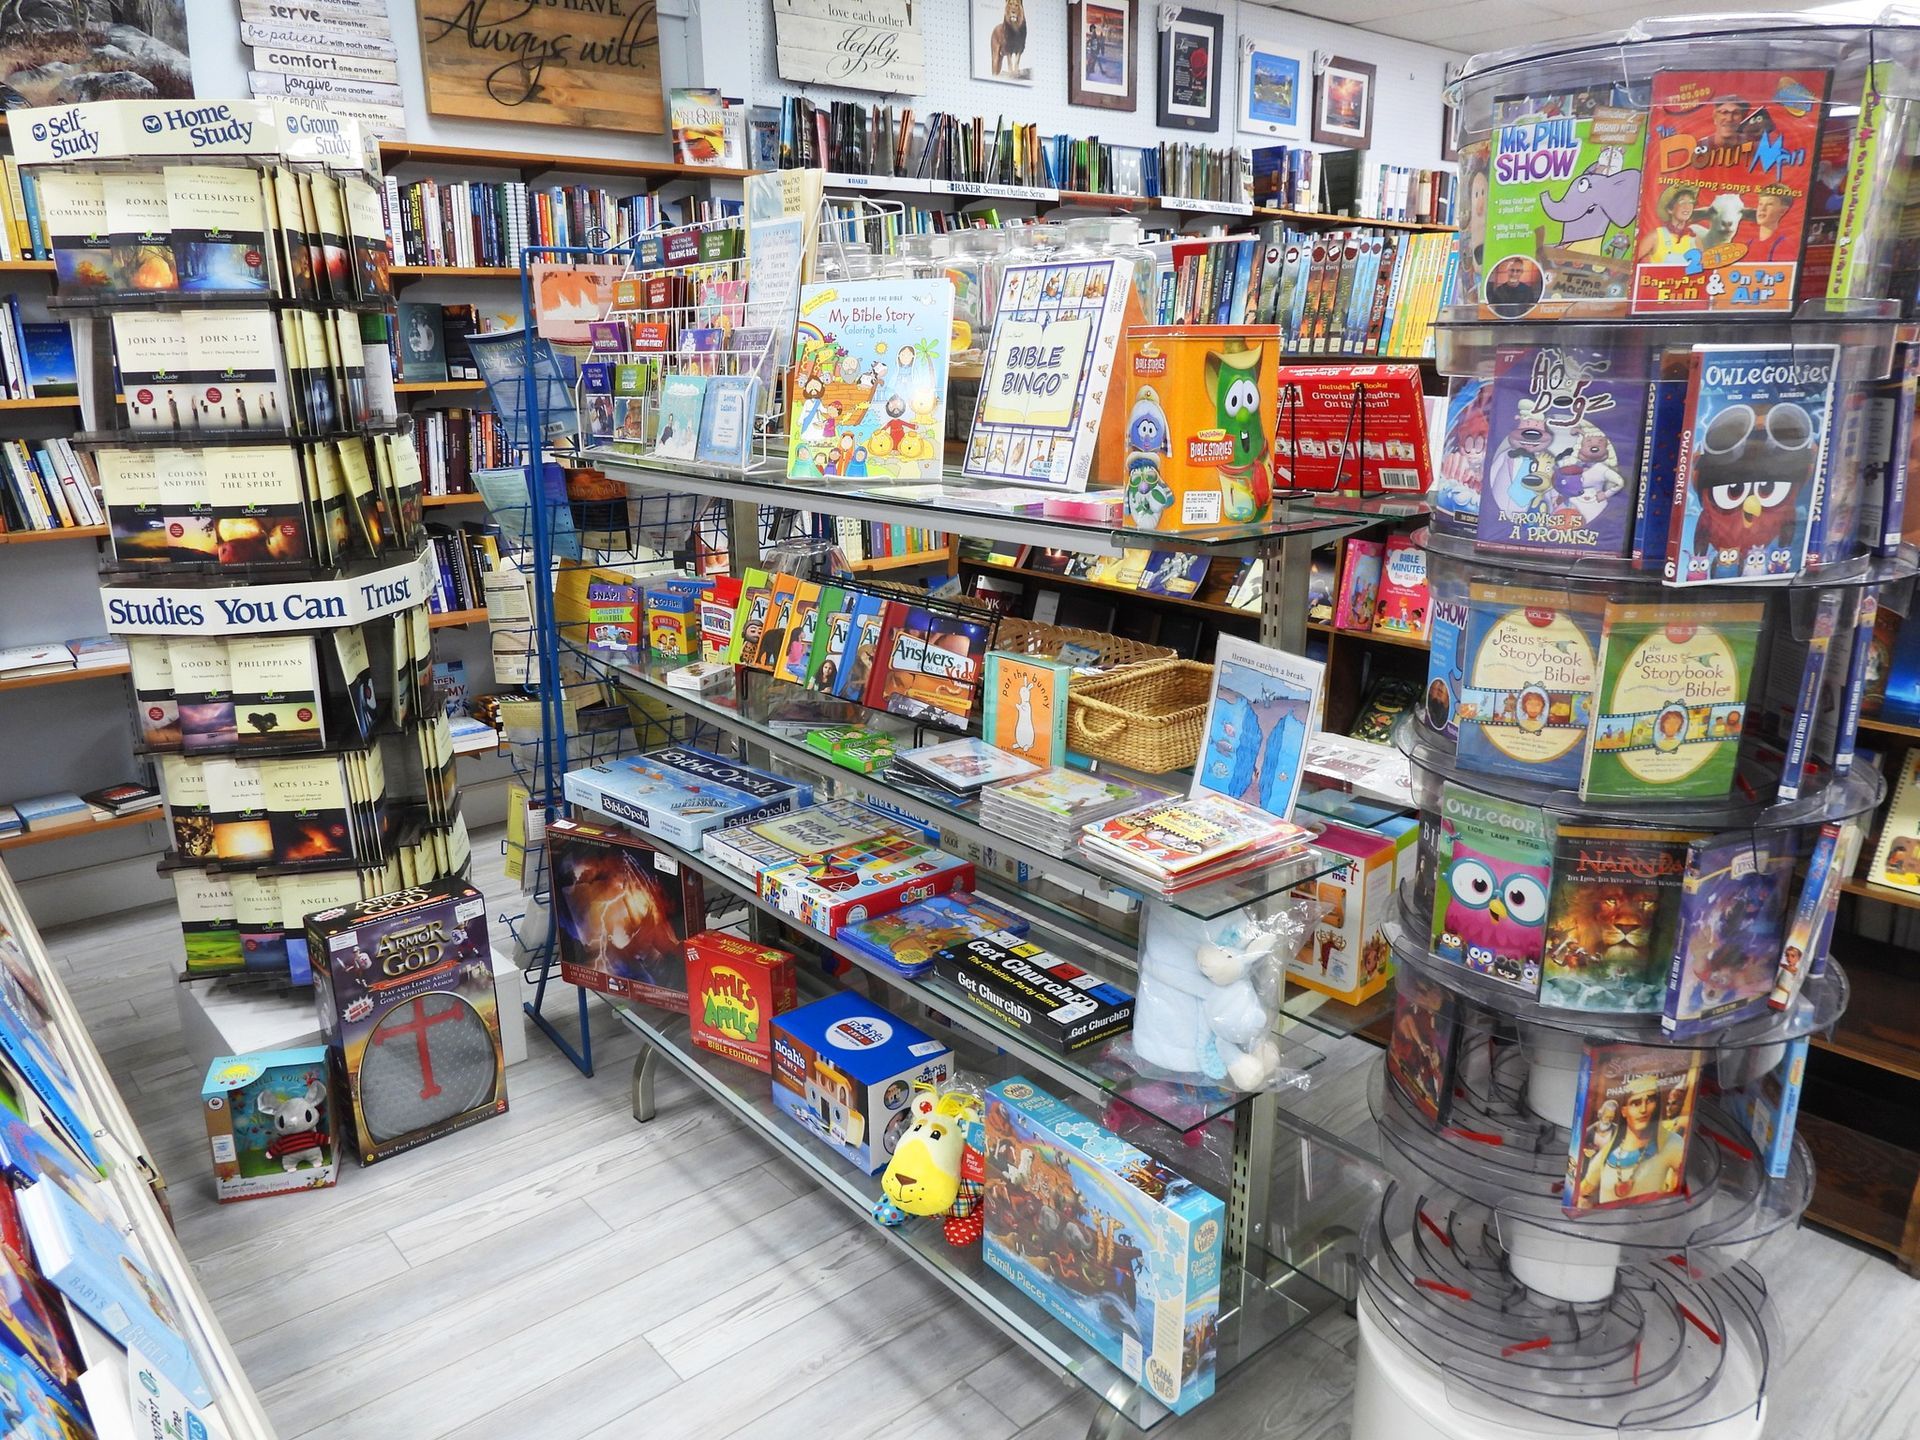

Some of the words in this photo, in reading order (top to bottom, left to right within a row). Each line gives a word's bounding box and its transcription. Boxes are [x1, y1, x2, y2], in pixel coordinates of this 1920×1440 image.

[270, 5, 321, 22] serve
[337, 19, 369, 28] another.
[828, 6, 849, 18] love
[852, 10, 875, 22] each
[877, 13, 905, 27] other
[248, 25, 269, 38] be
[270, 29, 328, 44] patient
[329, 39, 345, 47] with
[346, 41, 363, 49] each
[425, 0, 572, 106] Always
[580, 2, 659, 69] will.
[826, 26, 900, 79] deeply.
[269, 53, 337, 70] comfort
[354, 66, 384, 75] another.
[284, 74, 332, 96] forgive
[48, 108, 88, 138] Self-
[167, 104, 232, 131] Home
[299, 114, 340, 137] Group
[50, 127, 100, 159] Study
[191, 119, 253, 148] Study
[1532, 119, 1579, 152] PHIL
[315, 135, 351, 159] Study
[1496, 150, 1577, 183] SHOW
[954, 182, 982, 193] BAKER
[983, 187, 1006, 196] Sermon
[1007, 188, 1028, 197] Outline
[1029, 190, 1046, 198] Series
[1658, 176, 1718, 191] sing-a-long
[1720, 181, 1752, 192] songs
[1765, 186, 1803, 198] stories
[70, 199, 88, 207] THE
[174, 192, 256, 205] ECCLESIASTES
[204, 231, 233, 240] LifeGuide
[1684, 247, 1704, 275] 2
[1640, 275, 1706, 289] Barnyard
[1706, 274, 1725, 296] &
[1729, 270, 1752, 285] On
[1754, 270, 1785, 284] The
[1657, 287, 1699, 304] Fun
[1731, 286, 1775, 305] Air
[828, 307, 849, 328] My
[852, 307, 882, 323] Bible
[884, 307, 916, 327] Story
[128, 336, 157, 345] JOHN
[200, 335, 228, 344] JOHN
[844, 324, 875, 337] Coloring
[877, 324, 898, 335] Book
[1006, 346, 1066, 369] BIBLE
[1135, 357, 1148, 370] BIBLE
[1148, 357, 1166, 370] STORIES
[152, 373, 179, 382] LifeGuide
[220, 371, 247, 380] LifeGuide
[1324, 400, 1339, 408] On
[1643, 382, 1656, 433] GOSPEL
[1190, 441, 1208, 458] BIBLE
[1208, 440, 1233, 458] STORIES
[1194, 455, 1229, 463] COLLECTION
[1640, 436, 1652, 478] BIBLE
[221, 481, 242, 489] THE
[246, 480, 283, 489] SPIRIT
[224, 471, 257, 480] FRUIT
[261, 471, 276, 479] OF
[1636, 476, 1648, 519] SONGS
[1498, 511, 1507, 521] A
[1511, 511, 1565, 526] PROMISE
[1568, 514, 1582, 527] IS
[1509, 528, 1521, 540] A
[1527, 526, 1600, 547] PROMISE
[1391, 563, 1425, 575] MINUTES
[1399, 553, 1420, 564] BIBLE
[1663, 561, 1677, 579] 6
[109, 597, 206, 628] Studies
[215, 597, 279, 627] You
[282, 594, 347, 620] Can
[361, 575, 412, 612] Trust
[593, 591, 620, 600] SNAP!
[1436, 600, 1469, 629] SHOW
[1493, 630, 1535, 646] Jesus
[1506, 625, 1518, 633] the
[238, 658, 303, 669] PHILIPPIANS
[892, 639, 954, 668] Answers
[1232, 652, 1255, 665] Herman
[1256, 659, 1279, 674] catches
[1499, 645, 1583, 668] Storybook
[1635, 650, 1678, 667] Jesus
[181, 661, 212, 669] GOOD
[945, 661, 977, 687] Kids
[1640, 664, 1724, 686] Storybook
[1544, 666, 1587, 686] Bible
[1001, 677, 1013, 697] pat
[1031, 673, 1050, 710] bunny
[1684, 681, 1728, 698] Bible
[233, 779, 260, 788] LUKE
[273, 781, 299, 789] ACTS
[778, 824, 828, 846] BINGO
[795, 819, 846, 841] BIBLE
[1467, 825, 1484, 835] LION
[1490, 832, 1510, 841] LAMB
[1576, 849, 1687, 878] NARNIA
[1566, 874, 1578, 882] THE
[197, 891, 233, 899] PSALMS
[300, 897, 340, 905] ANGELS
[376, 919, 450, 958] ARMOR
[720, 938, 757, 953] EDITION
[383, 943, 446, 977] GOD
[719, 944, 745, 956] BIBLE
[967, 940, 1005, 961] Get
[1001, 956, 1099, 1013] ChurchED
[967, 955, 983, 966] The
[980, 963, 1012, 984] Christian
[1011, 979, 1035, 996] Party
[1034, 993, 1060, 1008] Game
[702, 972, 755, 1010] APPLES
[957, 972, 977, 992] Get
[978, 984, 1033, 1026] ChurchED
[724, 997, 734, 1007] to
[967, 993, 977, 1002] The
[975, 996, 995, 1016] Christian
[994, 1010, 1009, 1024] Party
[1007, 1017, 1021, 1028] Game
[703, 994, 758, 1043] APPLES
[1070, 1026, 1087, 1038] Get
[1088, 1008, 1130, 1031] ChurchED
[706, 1032, 717, 1042] Game
[846, 1019, 886, 1043] noah's
[707, 1040, 728, 1054] BIBLE
[728, 1047, 759, 1065] EDITION
[774, 1038, 806, 1070] noah's
[777, 1064, 793, 1080] Memory
[915, 1063, 947, 1084] noah's
[1190, 1254, 1216, 1271] Family
[1192, 1264, 1217, 1280] Pieces
[986, 1246, 1017, 1283] Family
[1016, 1269, 1047, 1303] Pieces
[70, 1276, 108, 1310] BABY'S
